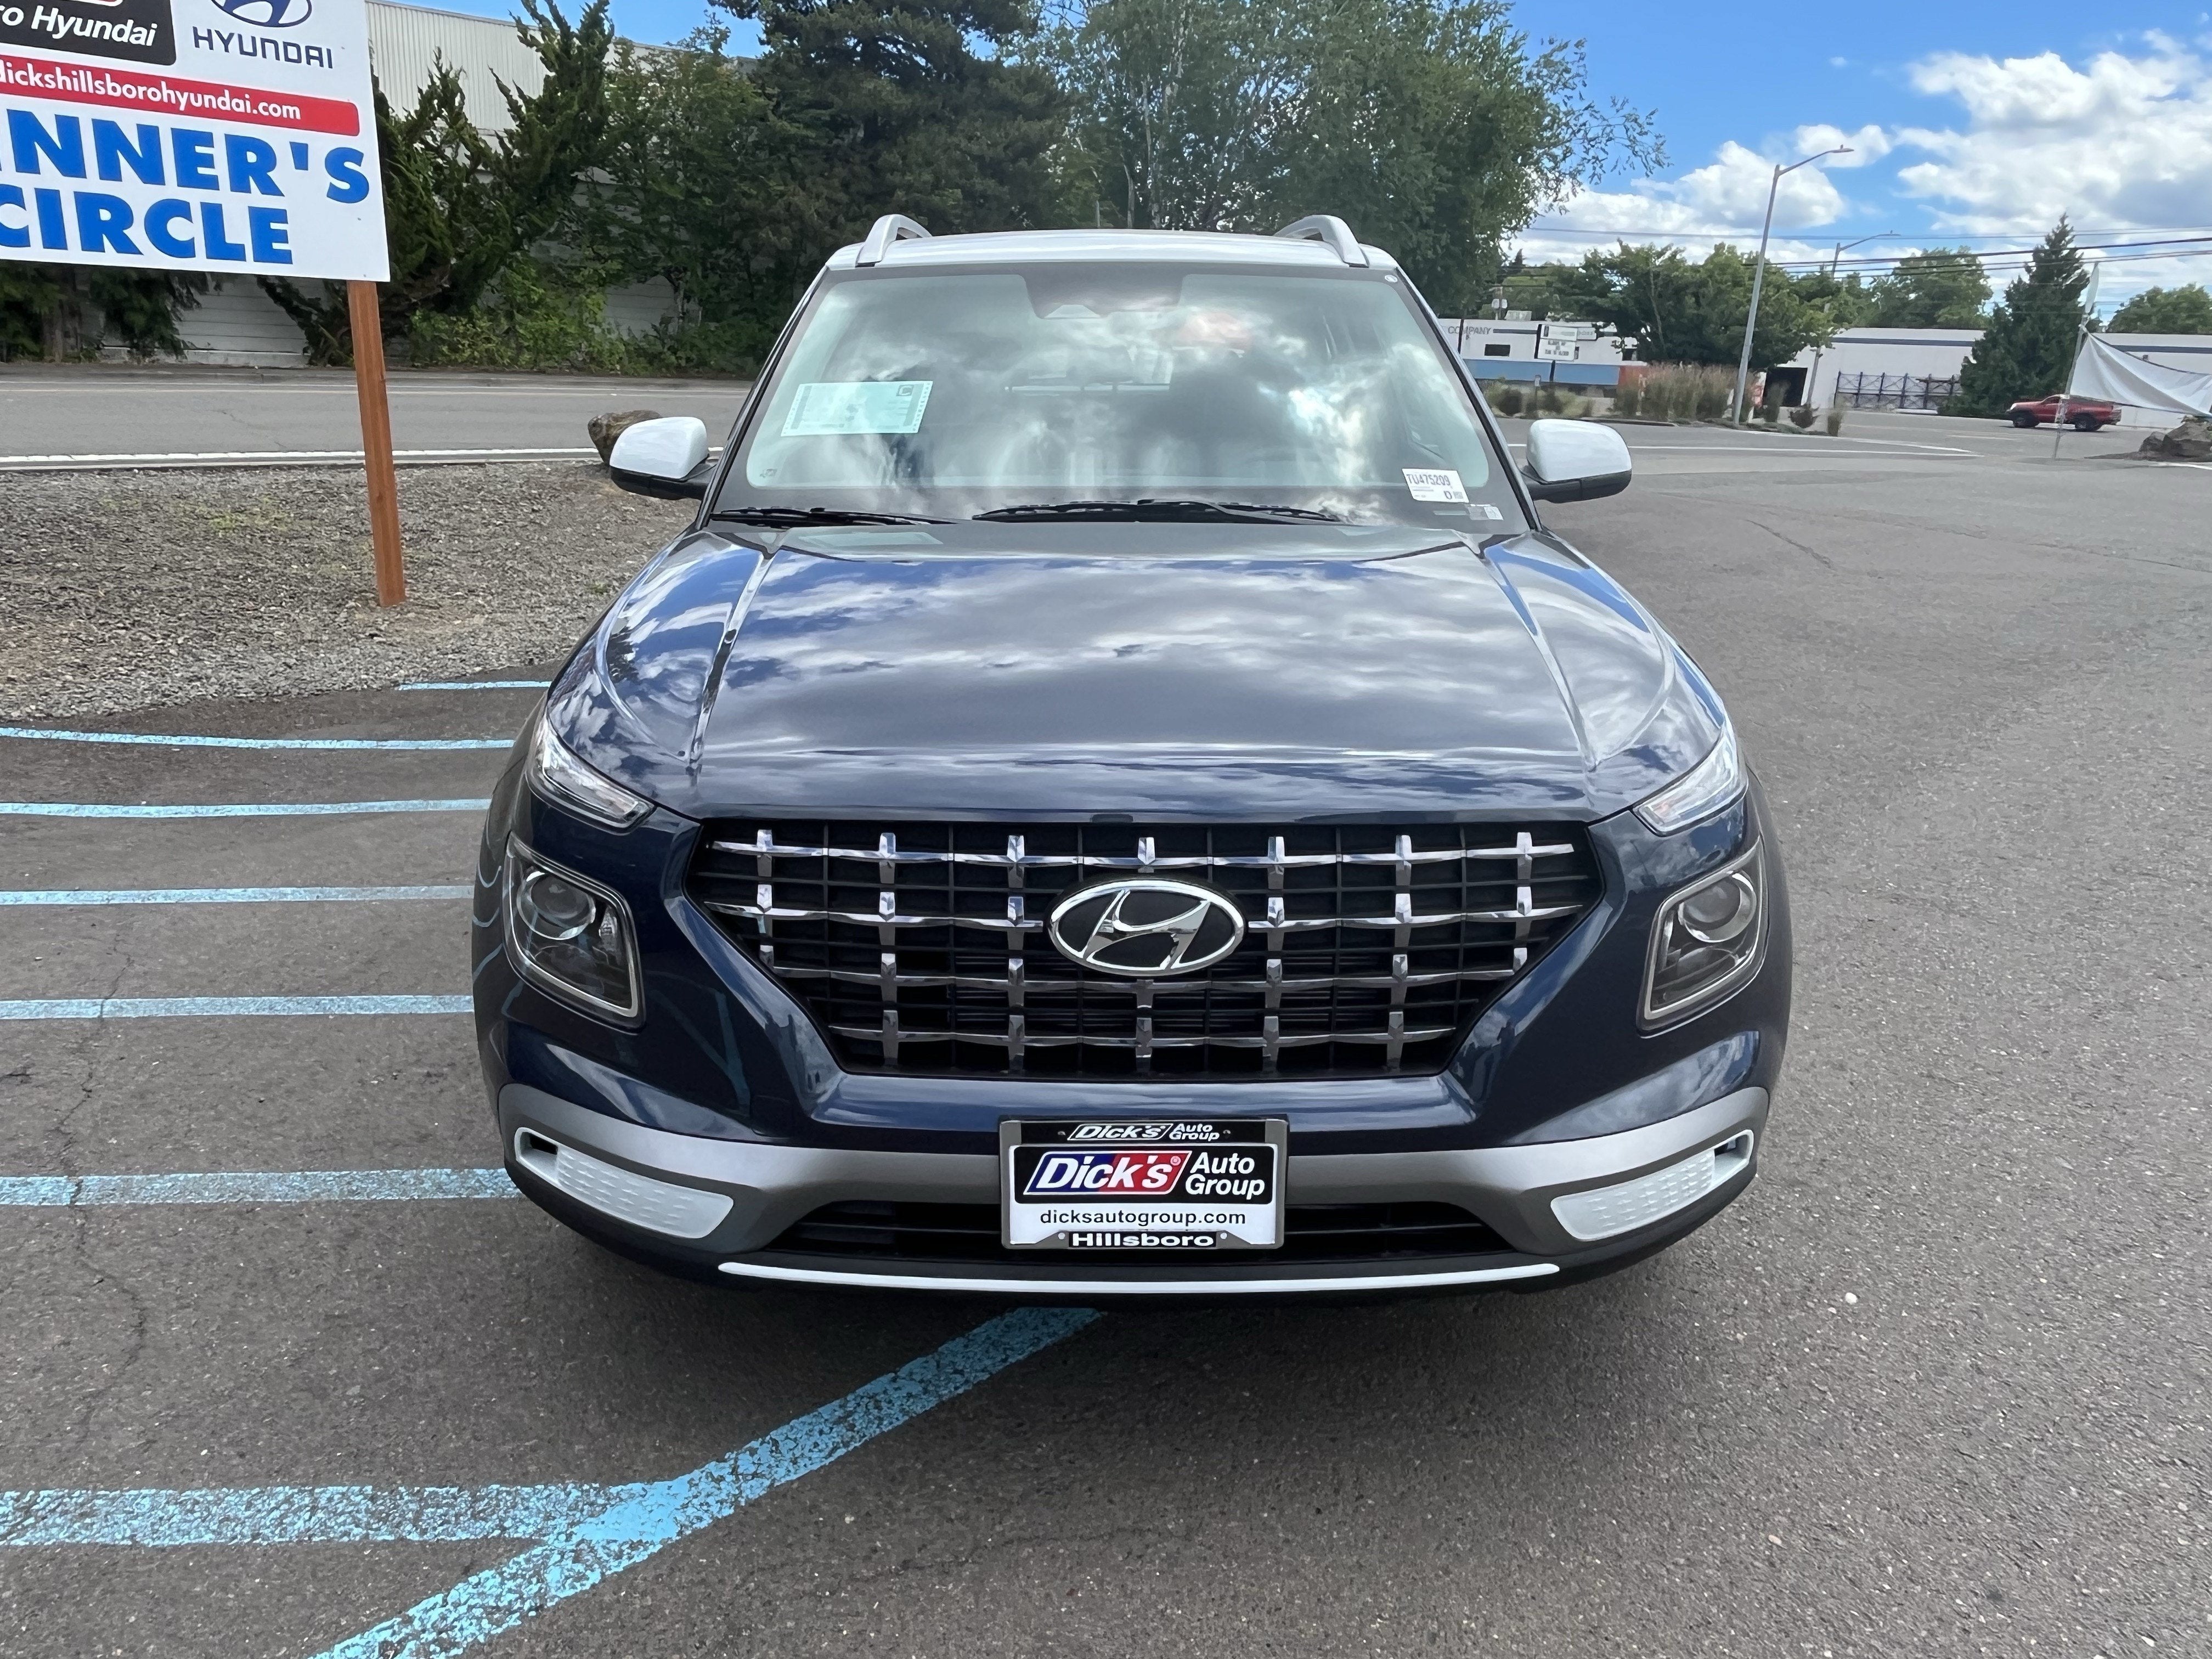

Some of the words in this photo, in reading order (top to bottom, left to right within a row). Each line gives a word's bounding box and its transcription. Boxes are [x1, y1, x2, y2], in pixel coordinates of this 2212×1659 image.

[31, 5, 158, 47] Hyundai
[193, 26, 334, 69] HYUNDAI
[0, 109, 370, 204] NNER'S
[0, 184, 294, 265] CIRCLE
[1406, 474, 1451, 486] TU475209
[1169, 1131, 1220, 1142] Group
[1173, 1123, 1213, 1132] Auto
[1035, 1155, 1173, 1189] Dick's
[1190, 1153, 1255, 1175] Auto
[1185, 1175, 1265, 1200] Group
[1040, 1210, 1246, 1227] dicksautogroup.com
[1072, 1232, 1215, 1246] Hillsboro
